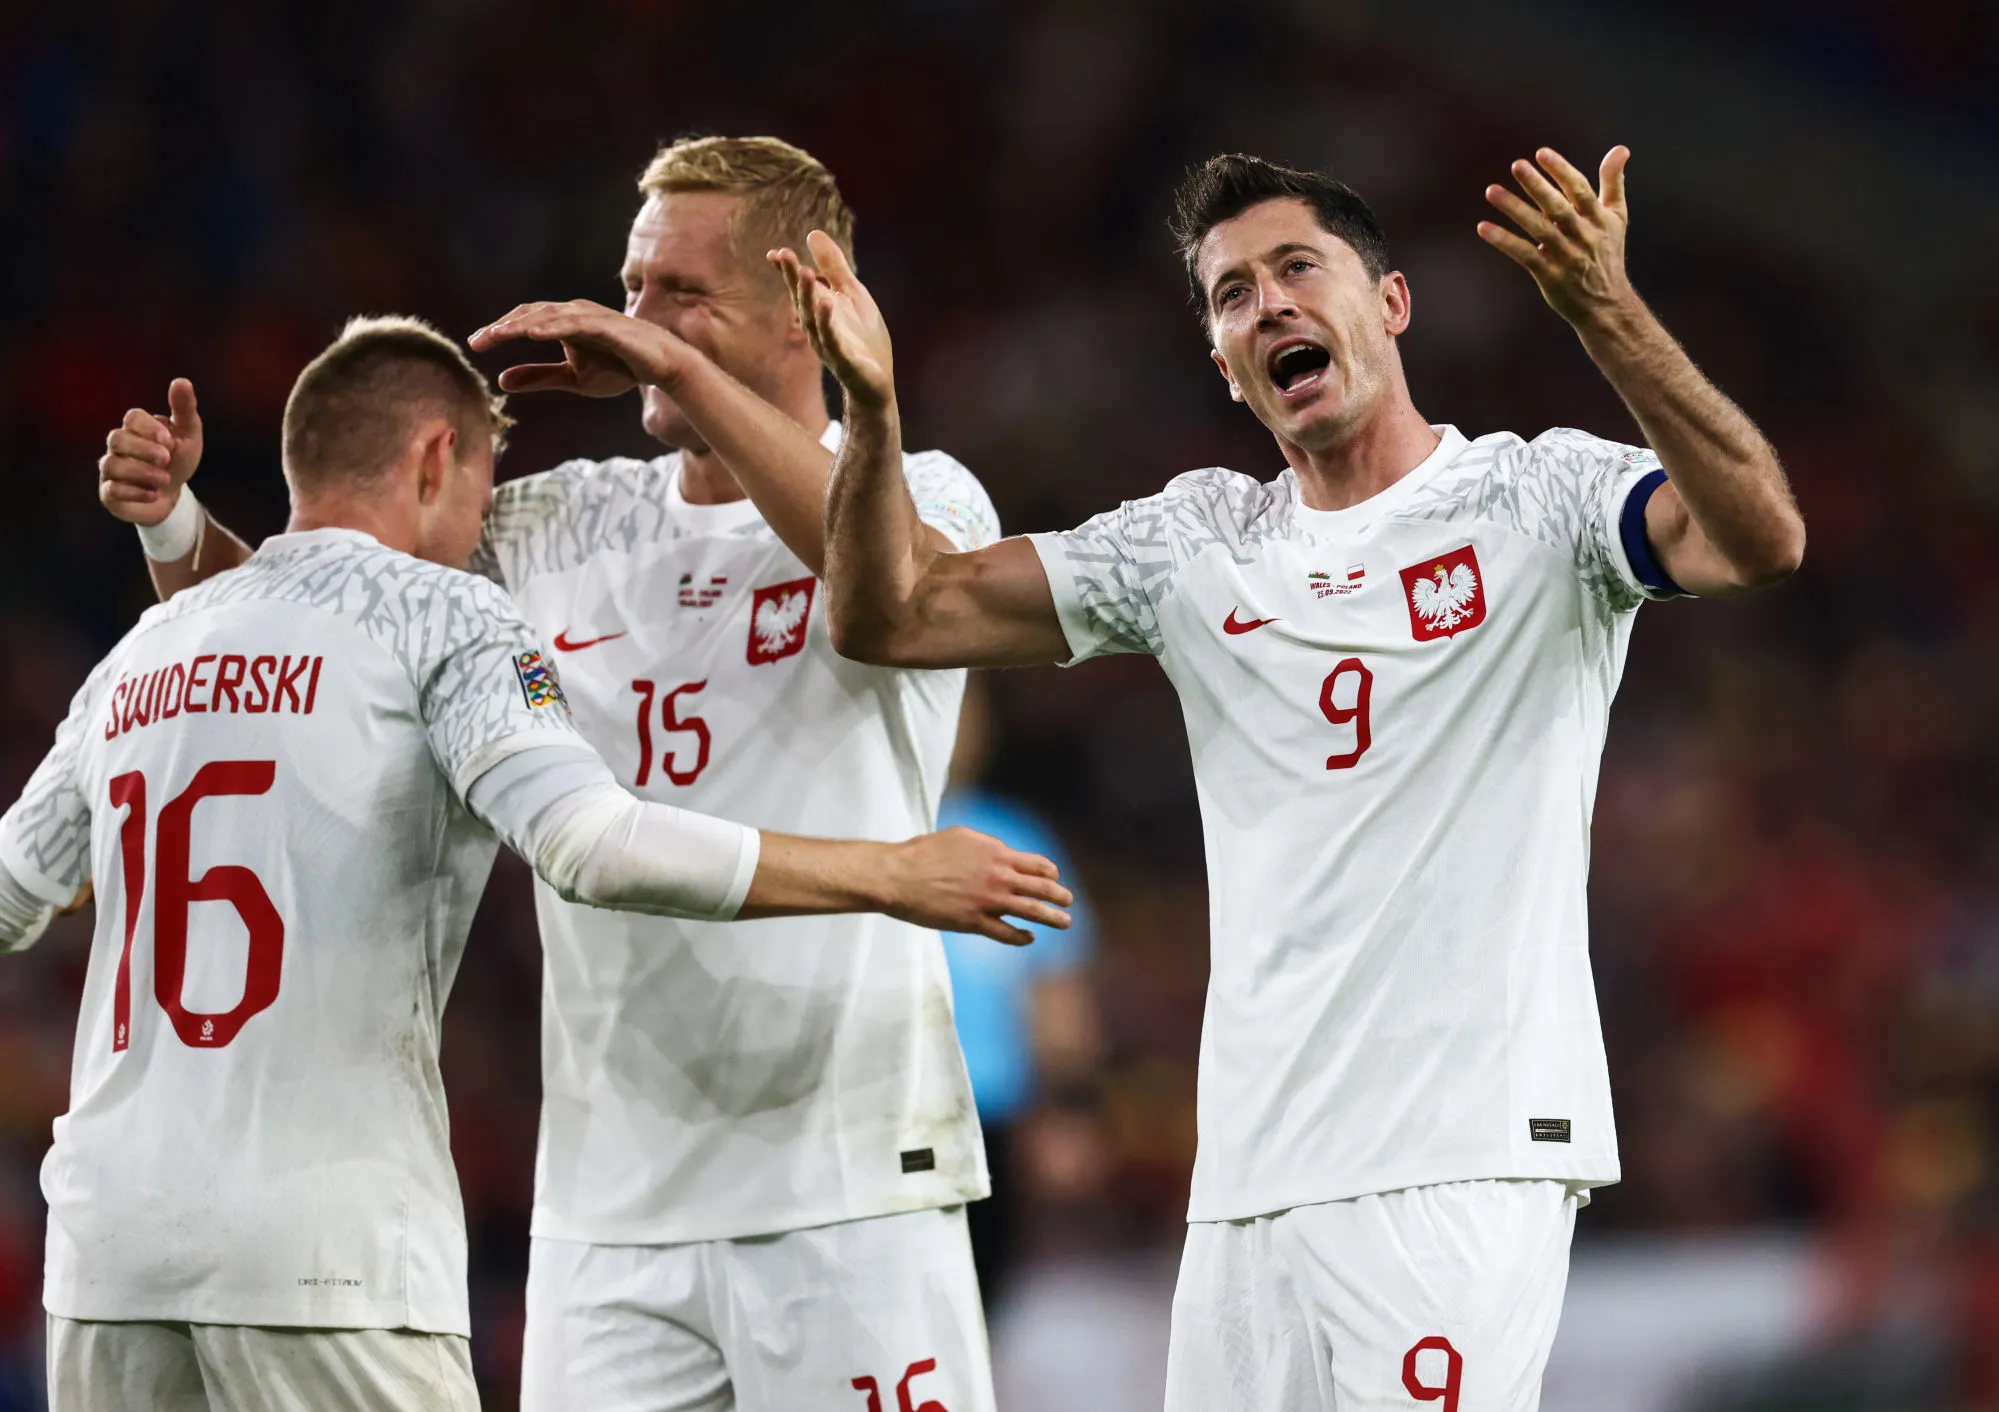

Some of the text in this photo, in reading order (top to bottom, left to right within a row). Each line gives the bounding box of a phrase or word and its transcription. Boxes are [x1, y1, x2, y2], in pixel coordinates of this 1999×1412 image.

[1310, 582, 1331, 590] WALES
[1317, 589, 1352, 599] 25.09.2022
[105, 654, 323, 741] ŚWIDERSKI
[632, 679, 711, 787] 15
[1319, 657, 1373, 770] 9
[109, 760, 285, 1053] 16
[1402, 1336, 1463, 1412] 9
